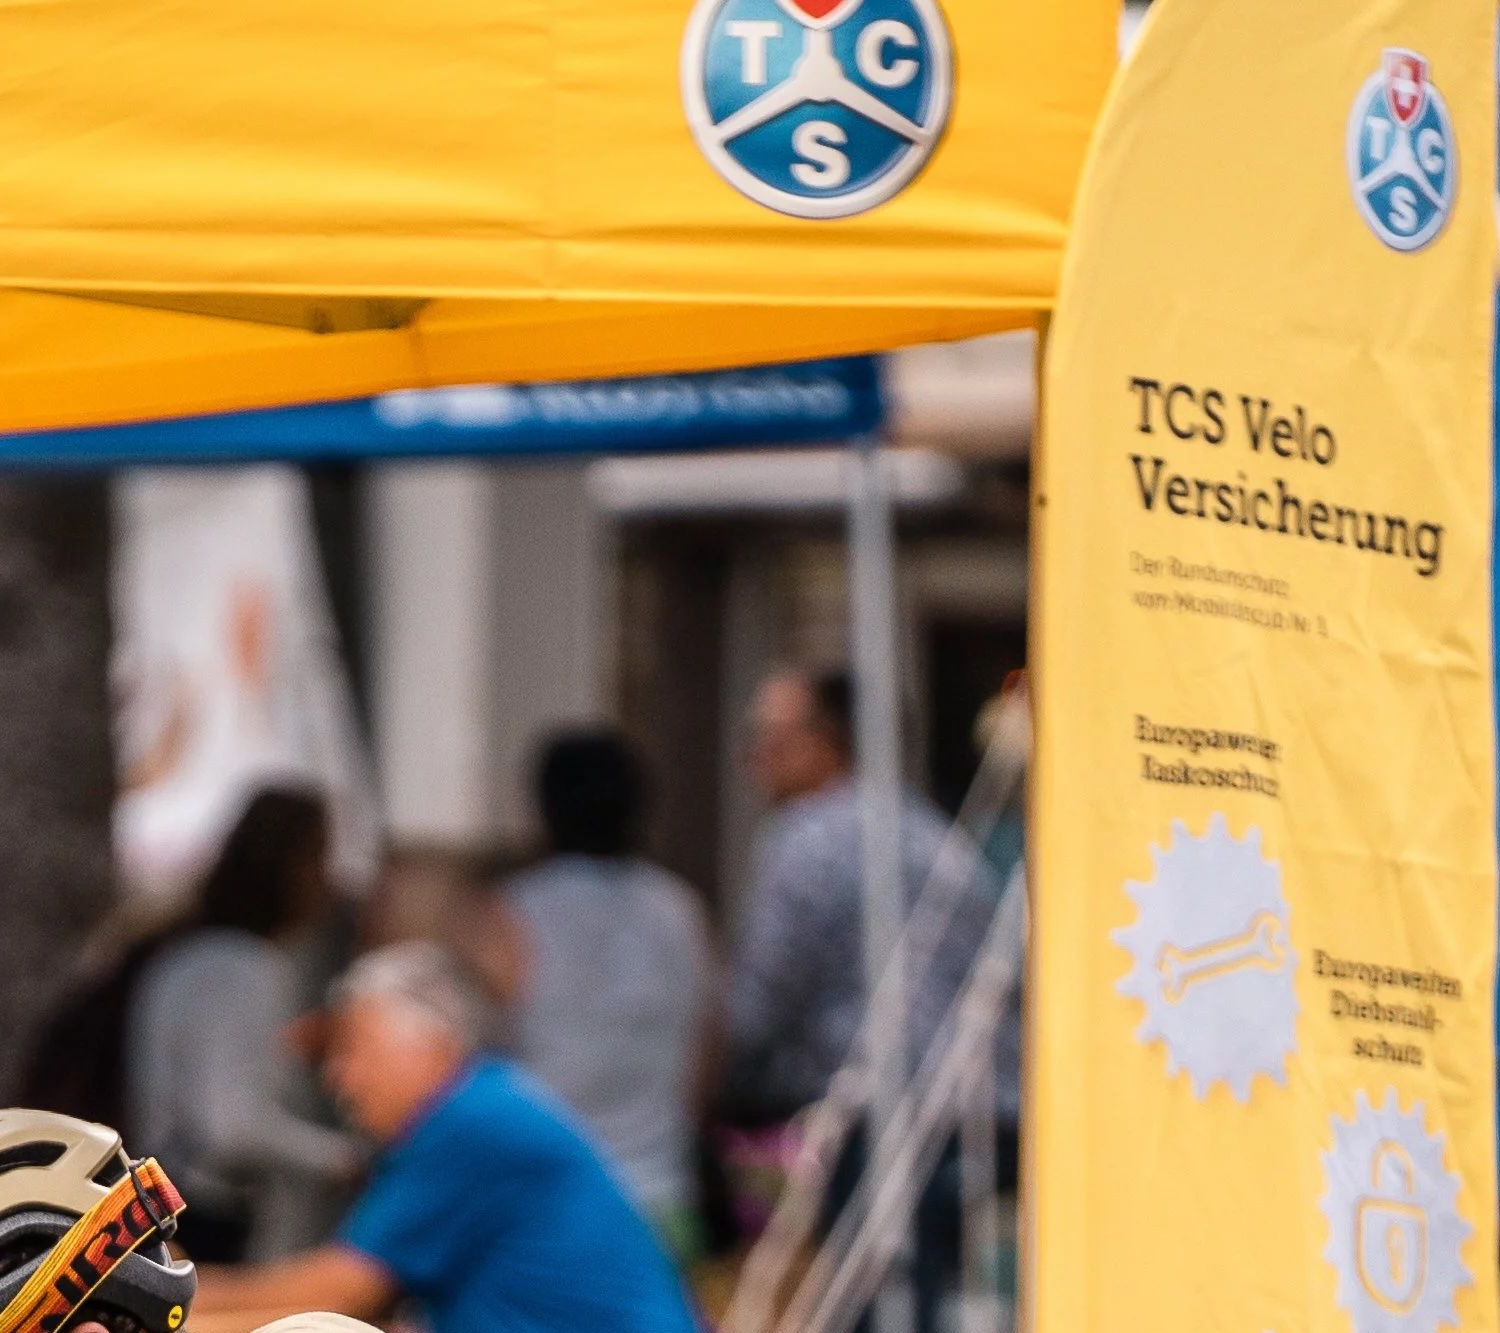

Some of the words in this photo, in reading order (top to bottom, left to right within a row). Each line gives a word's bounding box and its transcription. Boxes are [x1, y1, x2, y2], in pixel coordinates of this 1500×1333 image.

[724, 19, 919, 188] TCS
[1366, 115, 1446, 234] TCS
[1130, 376, 1226, 445] TCS
[1239, 395, 1337, 466] Velo
[1130, 453, 1444, 577] Versicherung
